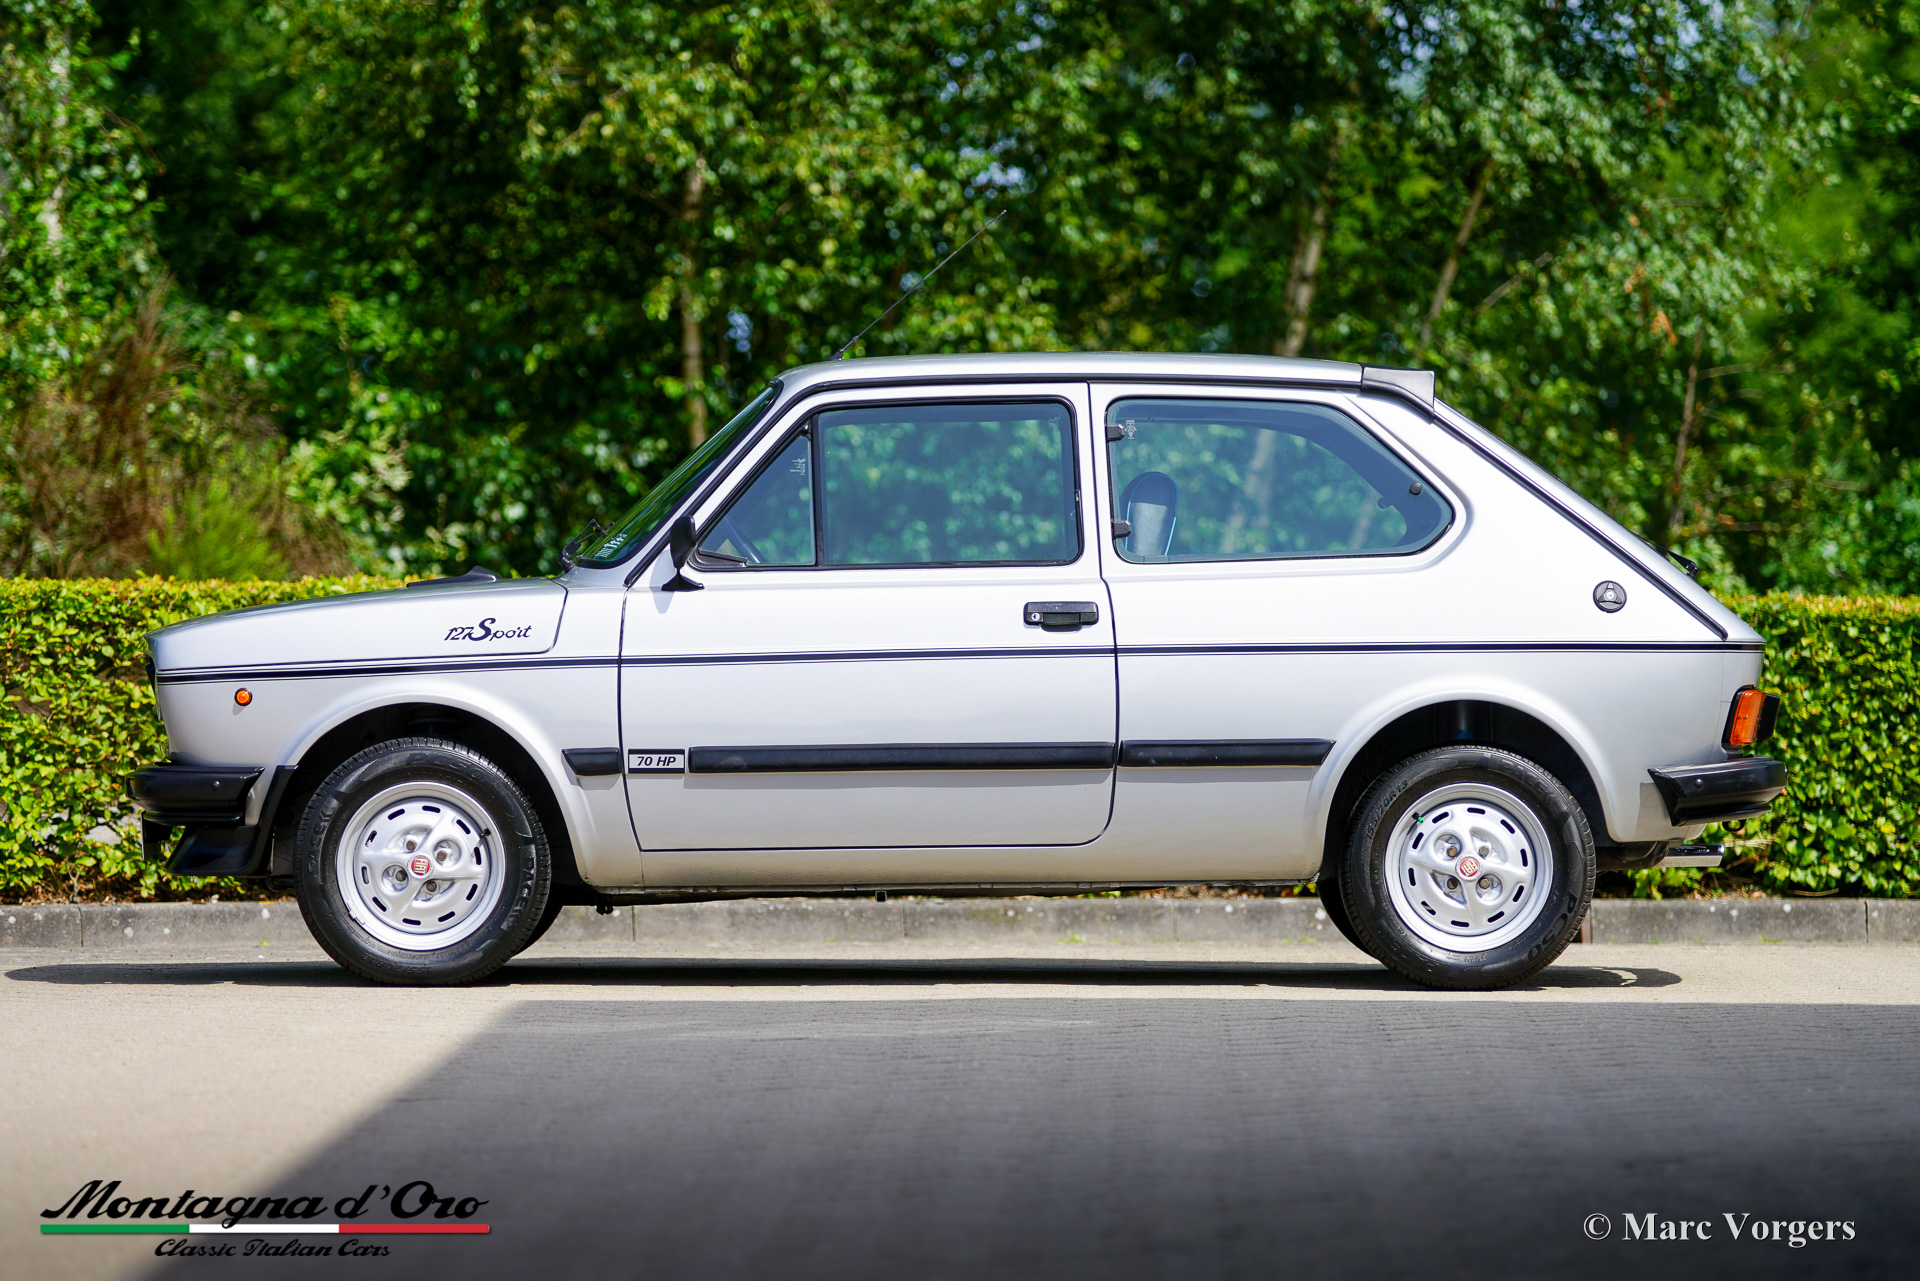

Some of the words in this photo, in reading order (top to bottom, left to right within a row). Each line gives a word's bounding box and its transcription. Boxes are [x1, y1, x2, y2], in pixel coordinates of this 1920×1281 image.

[637, 756, 653, 766] 70
[656, 756, 676, 766] HP
[1527, 890, 1578, 961] PC50
